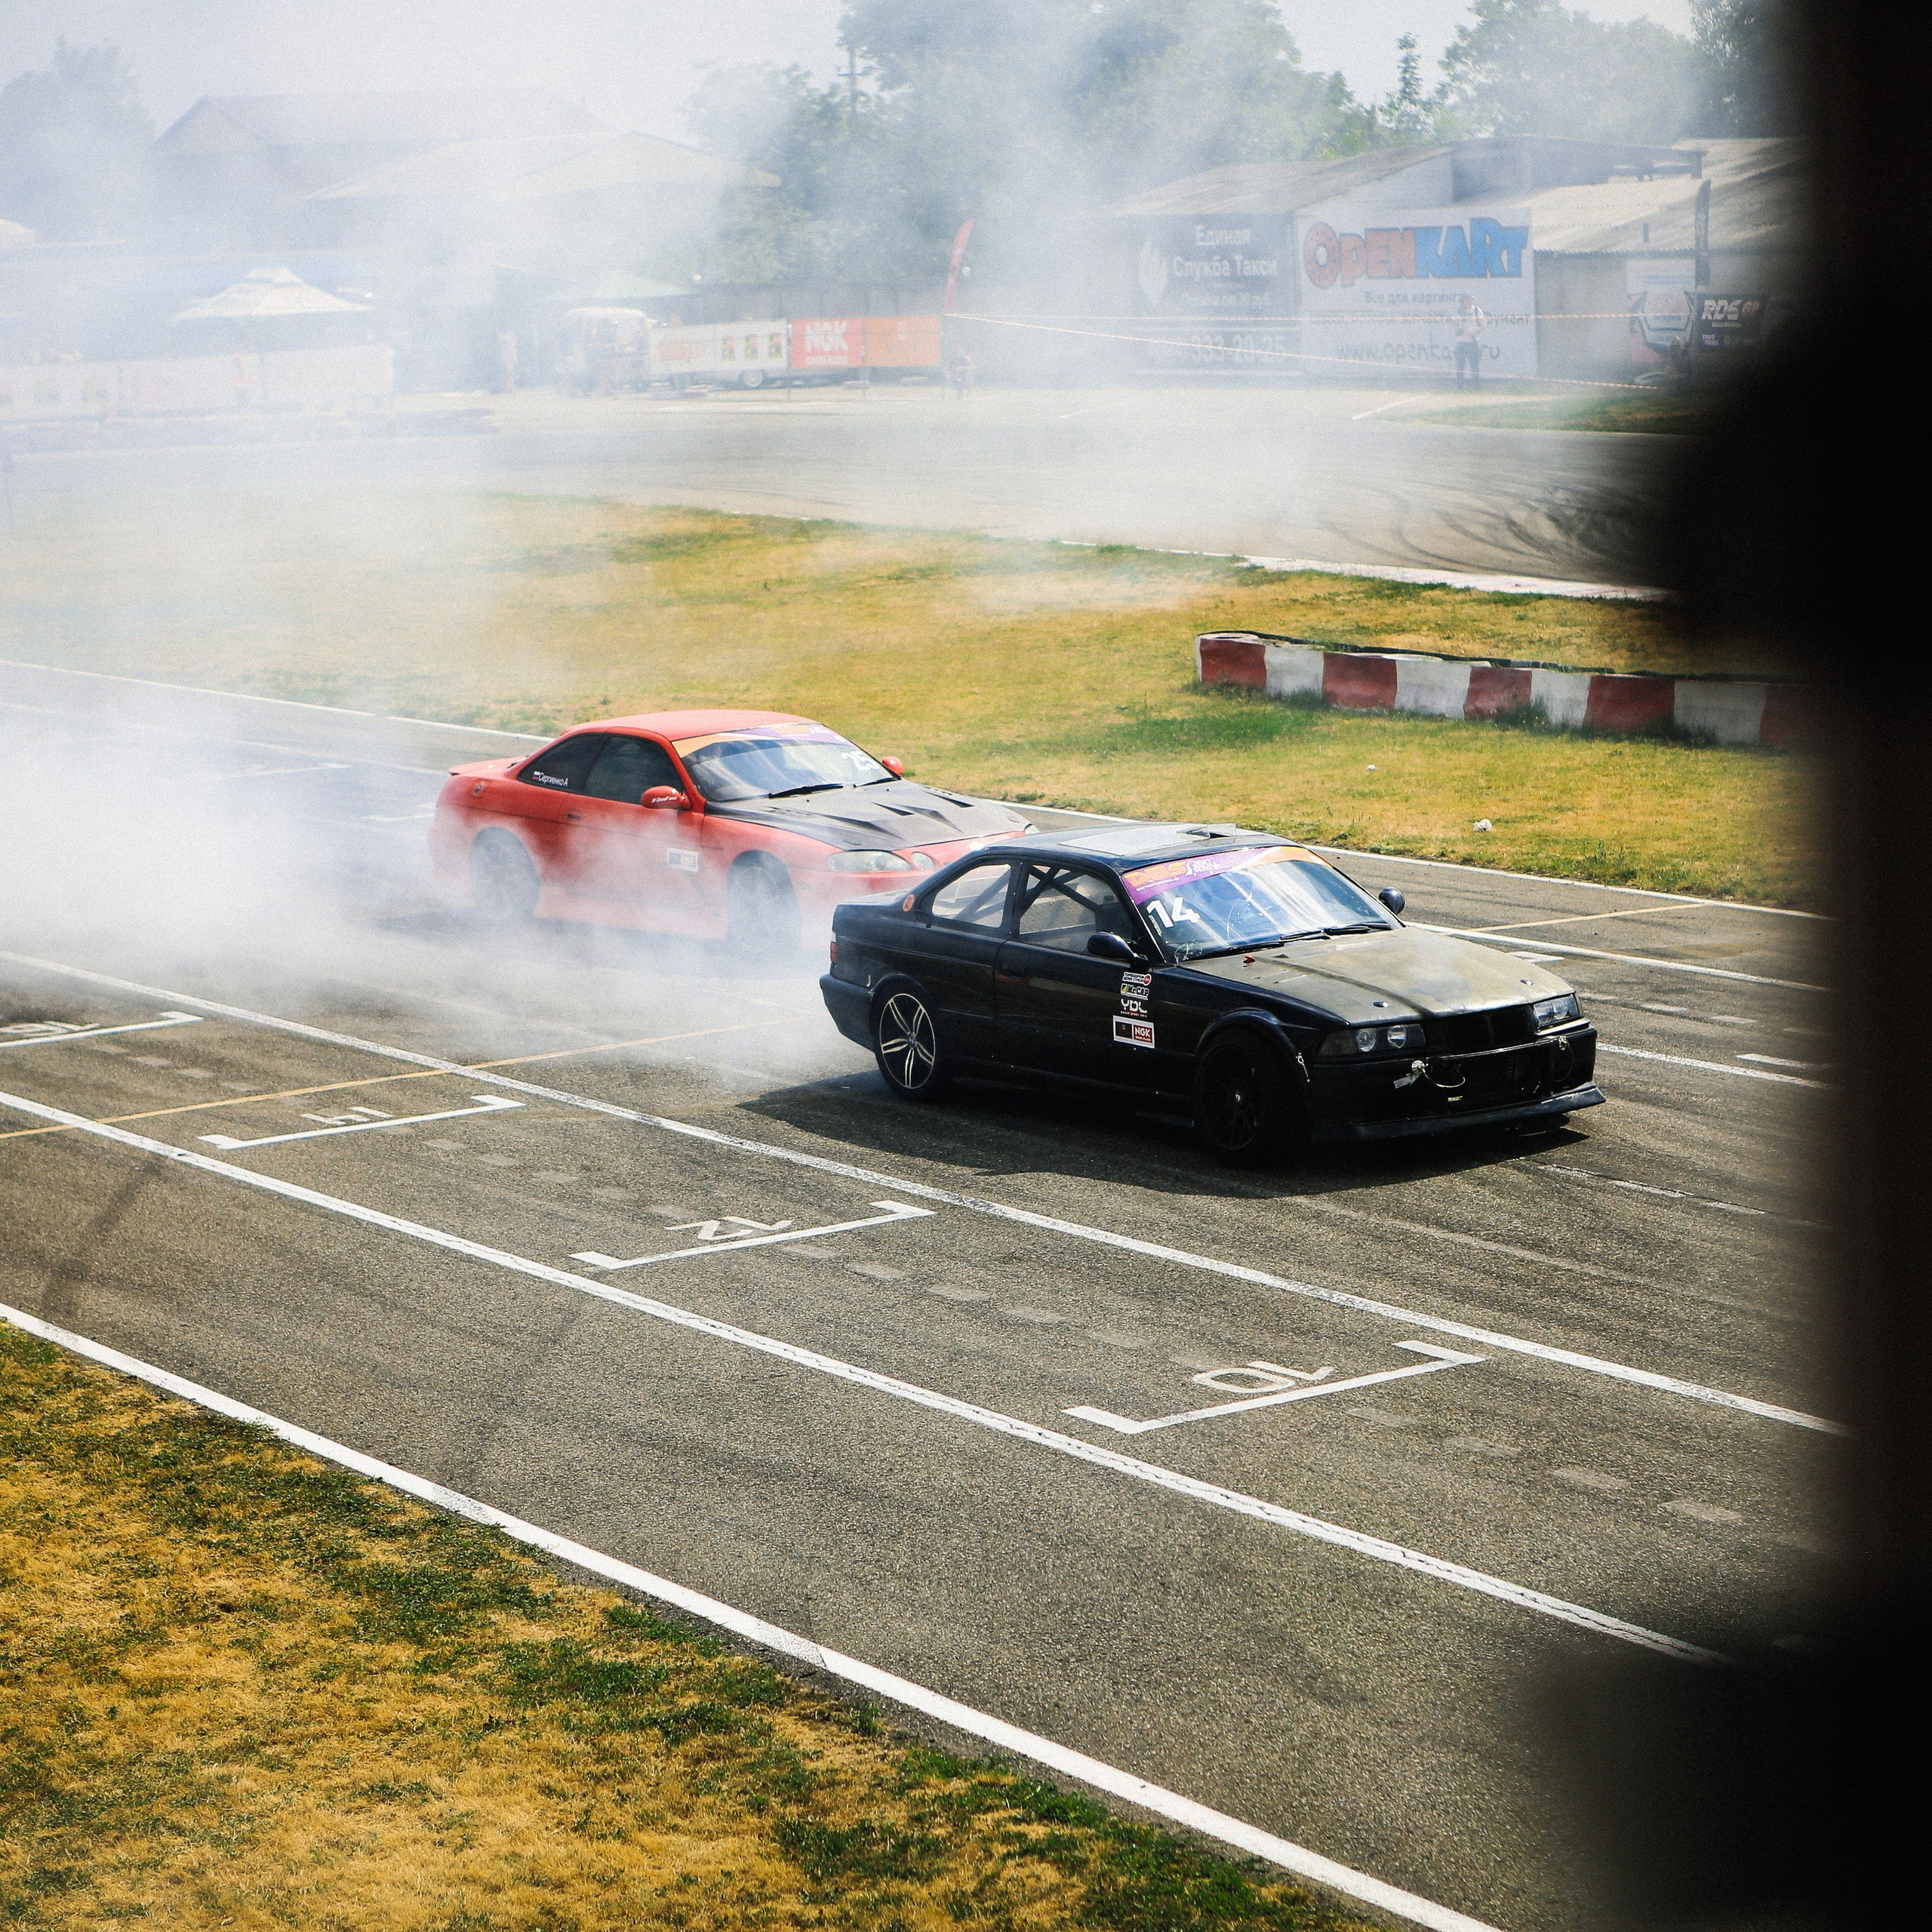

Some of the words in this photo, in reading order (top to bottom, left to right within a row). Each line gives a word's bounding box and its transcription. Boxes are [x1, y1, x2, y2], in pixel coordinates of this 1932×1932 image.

[1195, 225, 1251, 249] Единая
[1173, 255, 1231, 281] Служба
[1235, 254, 1278, 276] Такси
[1701, 299, 1743, 320] RDS
[805, 321, 848, 352] NGK
[1124, 862, 1186, 887] DBS
[1146, 897, 1201, 928] 14
[1121, 998, 1148, 1014] YDL
[1134, 1026, 1151, 1038] NGK
